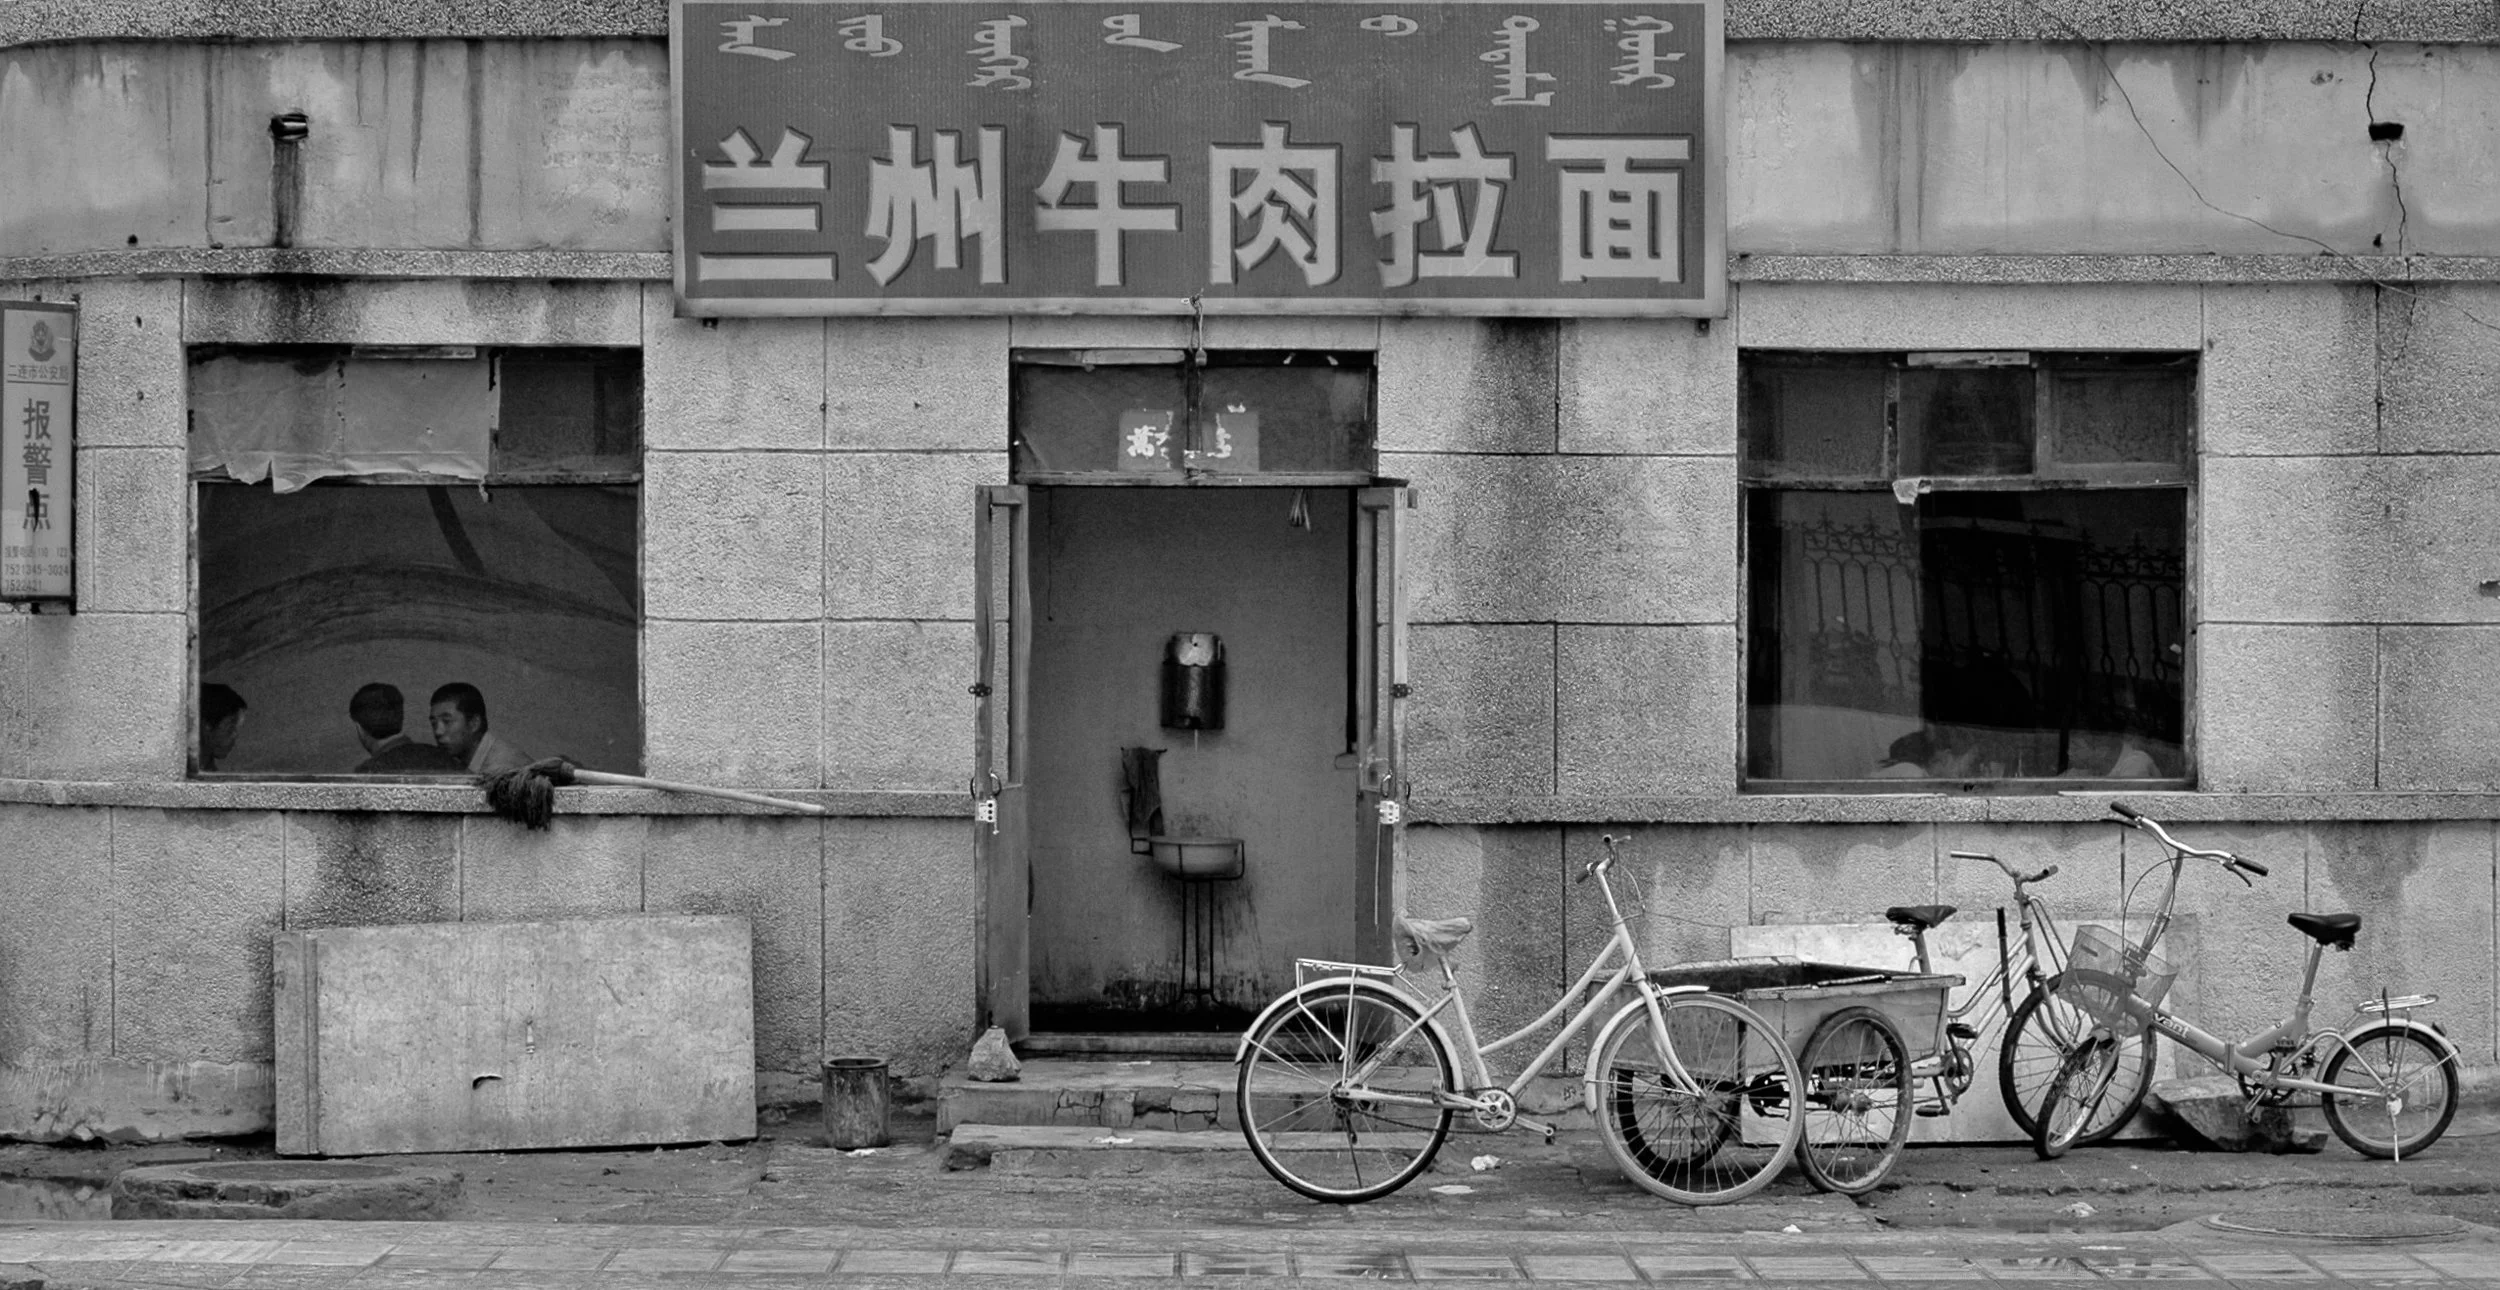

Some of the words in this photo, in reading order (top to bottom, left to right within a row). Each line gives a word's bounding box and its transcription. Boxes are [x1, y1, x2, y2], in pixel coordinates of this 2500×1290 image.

[699, 121, 1694, 288] 兰州牛肉拉面
[22, 398, 52, 531] 报警点
